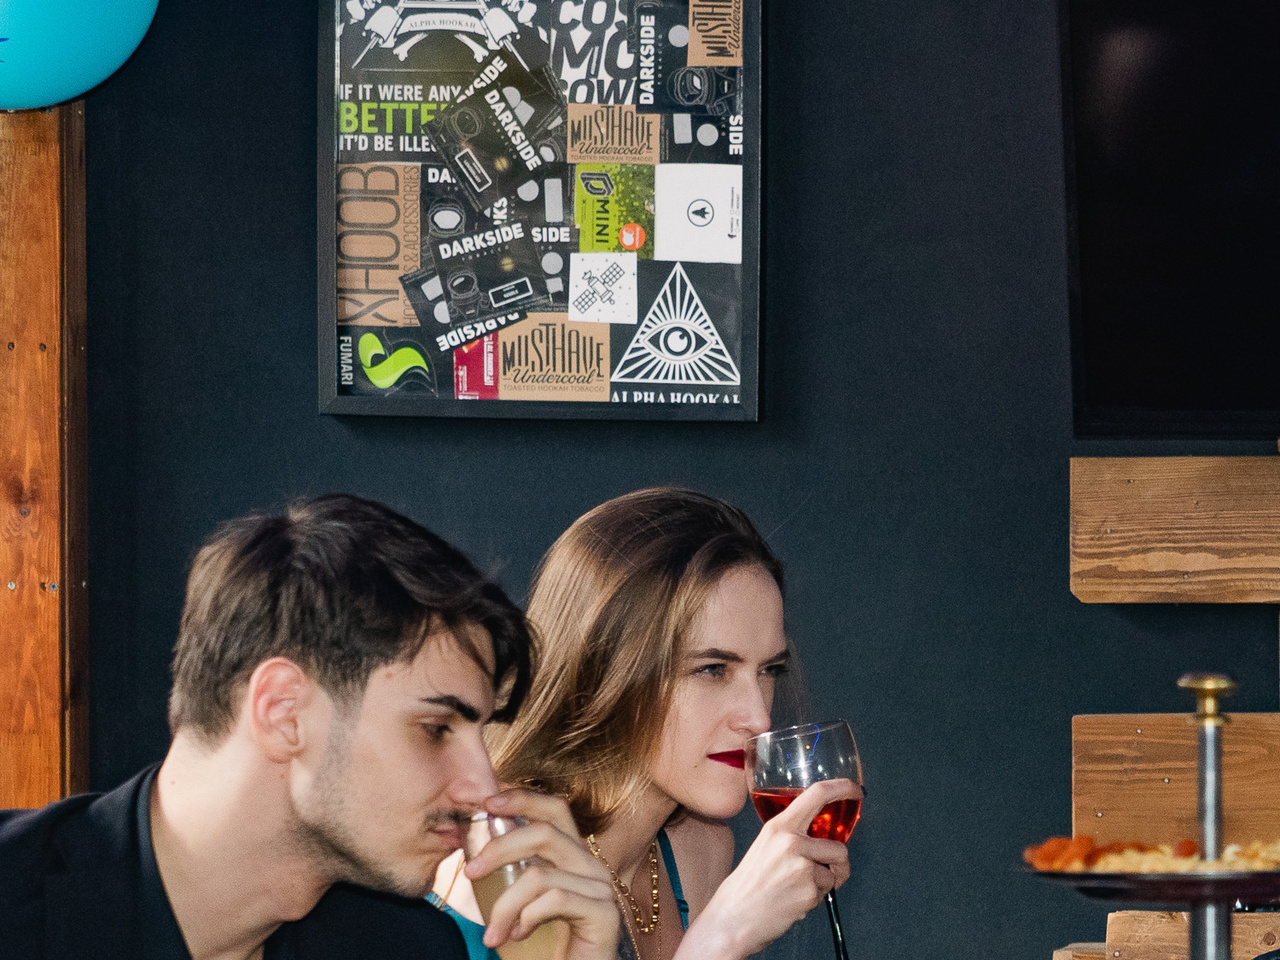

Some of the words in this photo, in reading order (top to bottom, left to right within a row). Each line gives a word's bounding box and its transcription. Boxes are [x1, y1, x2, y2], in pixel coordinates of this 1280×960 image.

[409, 20, 437, 29] ALPHA
[439, 19, 476, 29] HOOKAH
[551, 0, 628, 32] CO
[692, 0, 735, 58] MUSTH
[457, 55, 508, 103] SIDE
[640, 14, 656, 105] DARKSIDE
[340, 84, 353, 101] IF
[358, 84, 373, 101] IT
[378, 84, 424, 102] WERE
[429, 85, 462, 101] ANY
[340, 102, 448, 134] BETTE
[484, 89, 542, 171] DARKSIDE
[571, 105, 653, 149] MUSTHAVE
[340, 135, 369, 151] IT'D
[374, 135, 394, 151] BE
[400, 135, 437, 152] ILLE
[578, 141, 646, 155] Undercoal
[403, 165, 420, 250] ACCESSORIES
[596, 199, 610, 243] MINI
[438, 223, 525, 259] DARKSIDE
[340, 336, 354, 385] FUMARI
[502, 323, 604, 378] MUSTHAVE
[513, 368, 597, 384] Undercoal
[571, 385, 605, 393] TOBACCO
